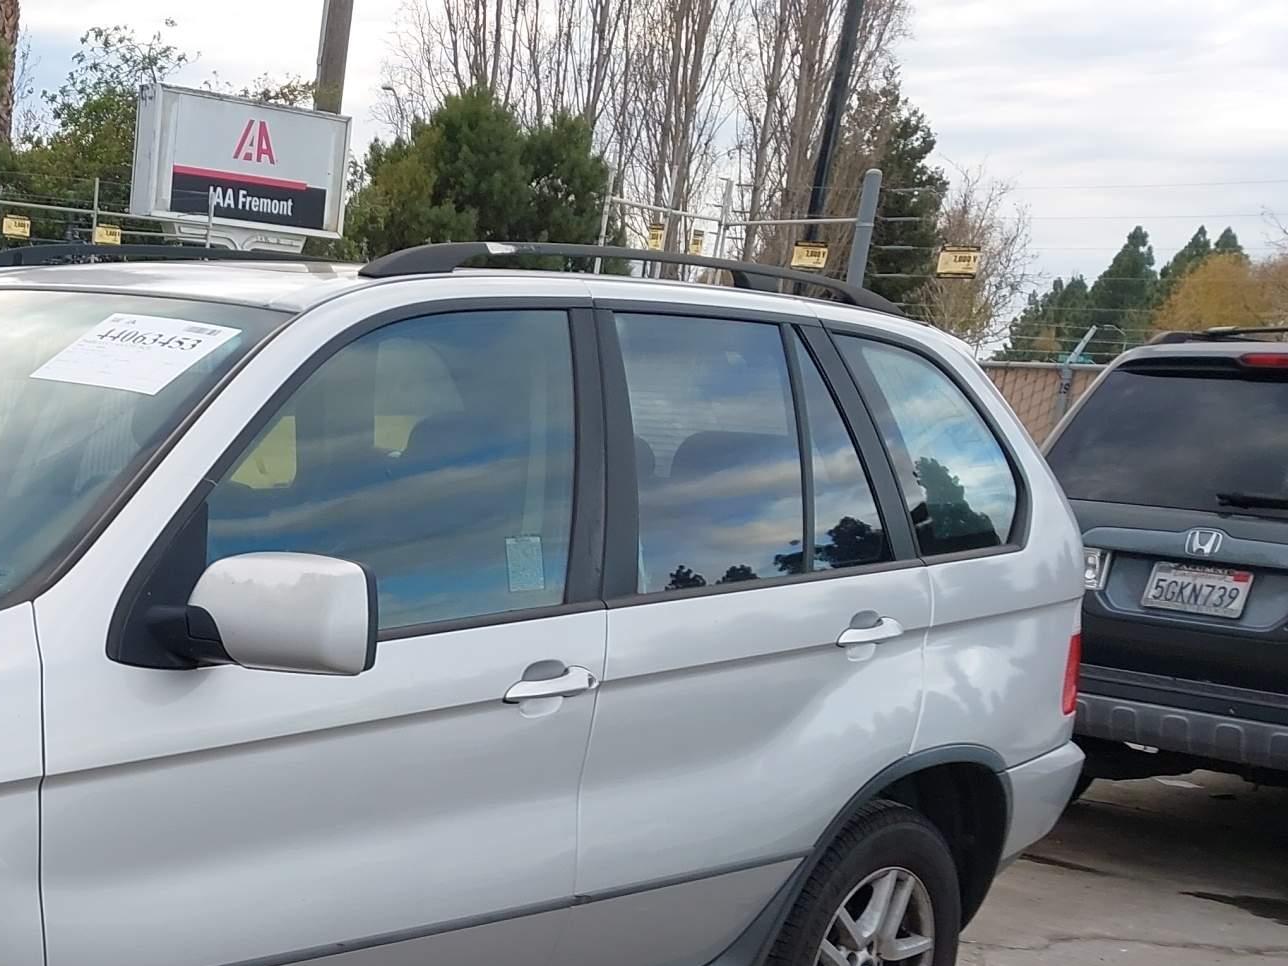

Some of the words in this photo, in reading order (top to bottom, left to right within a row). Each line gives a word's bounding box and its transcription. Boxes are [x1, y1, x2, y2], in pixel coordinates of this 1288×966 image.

[238, 189, 294, 217] Fremont
[96, 327, 202, 351] 44063453
[1151, 577, 1240, 609] 5GKN739
